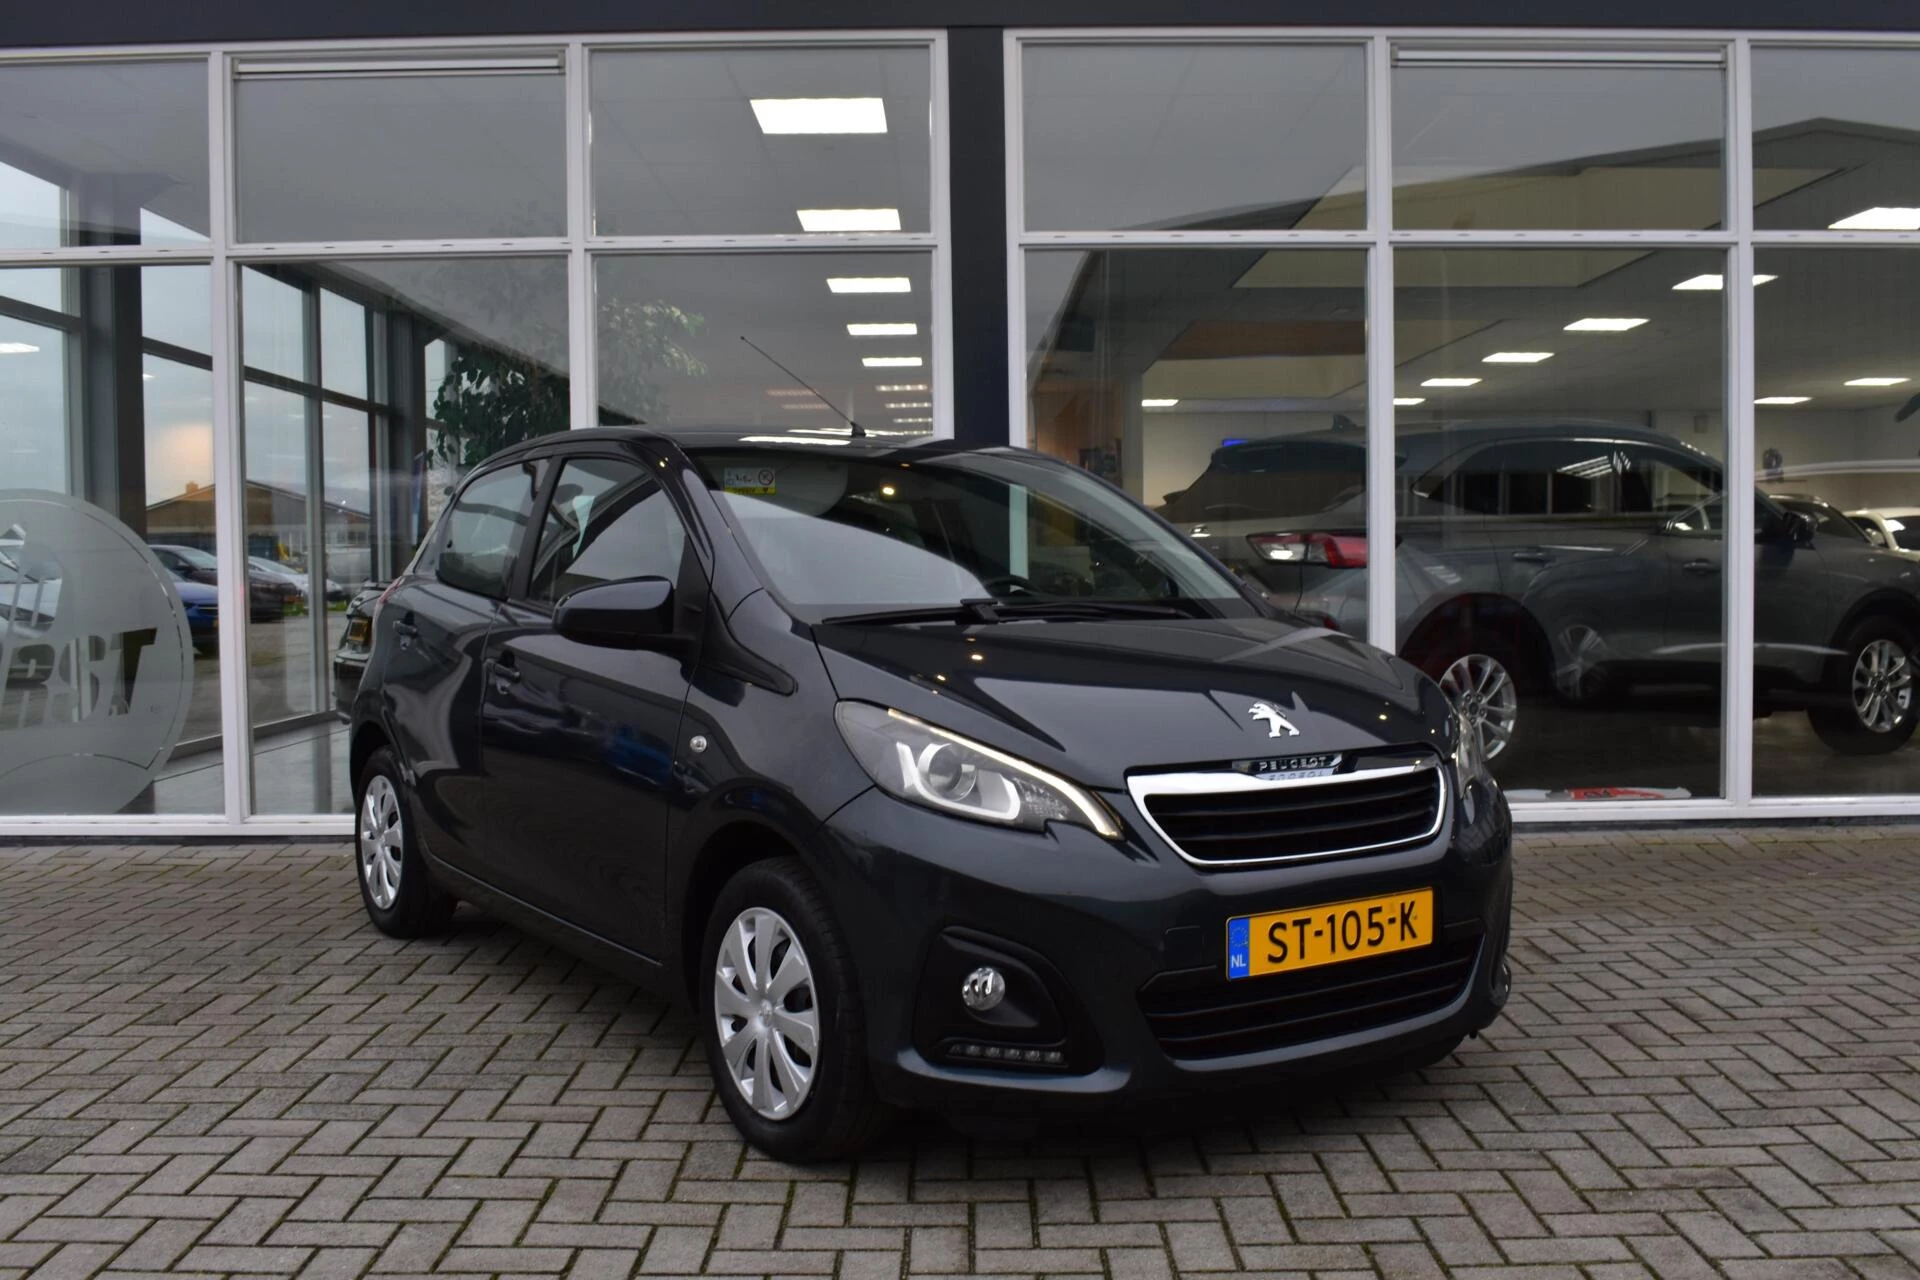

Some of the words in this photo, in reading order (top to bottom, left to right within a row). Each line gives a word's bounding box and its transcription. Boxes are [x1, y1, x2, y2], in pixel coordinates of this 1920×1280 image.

[0, 627, 158, 731] RST
[1258, 756, 1328, 772] PEUGEOT
[1266, 900, 1418, 964] ST-105-K
[1231, 953, 1247, 968] NL
